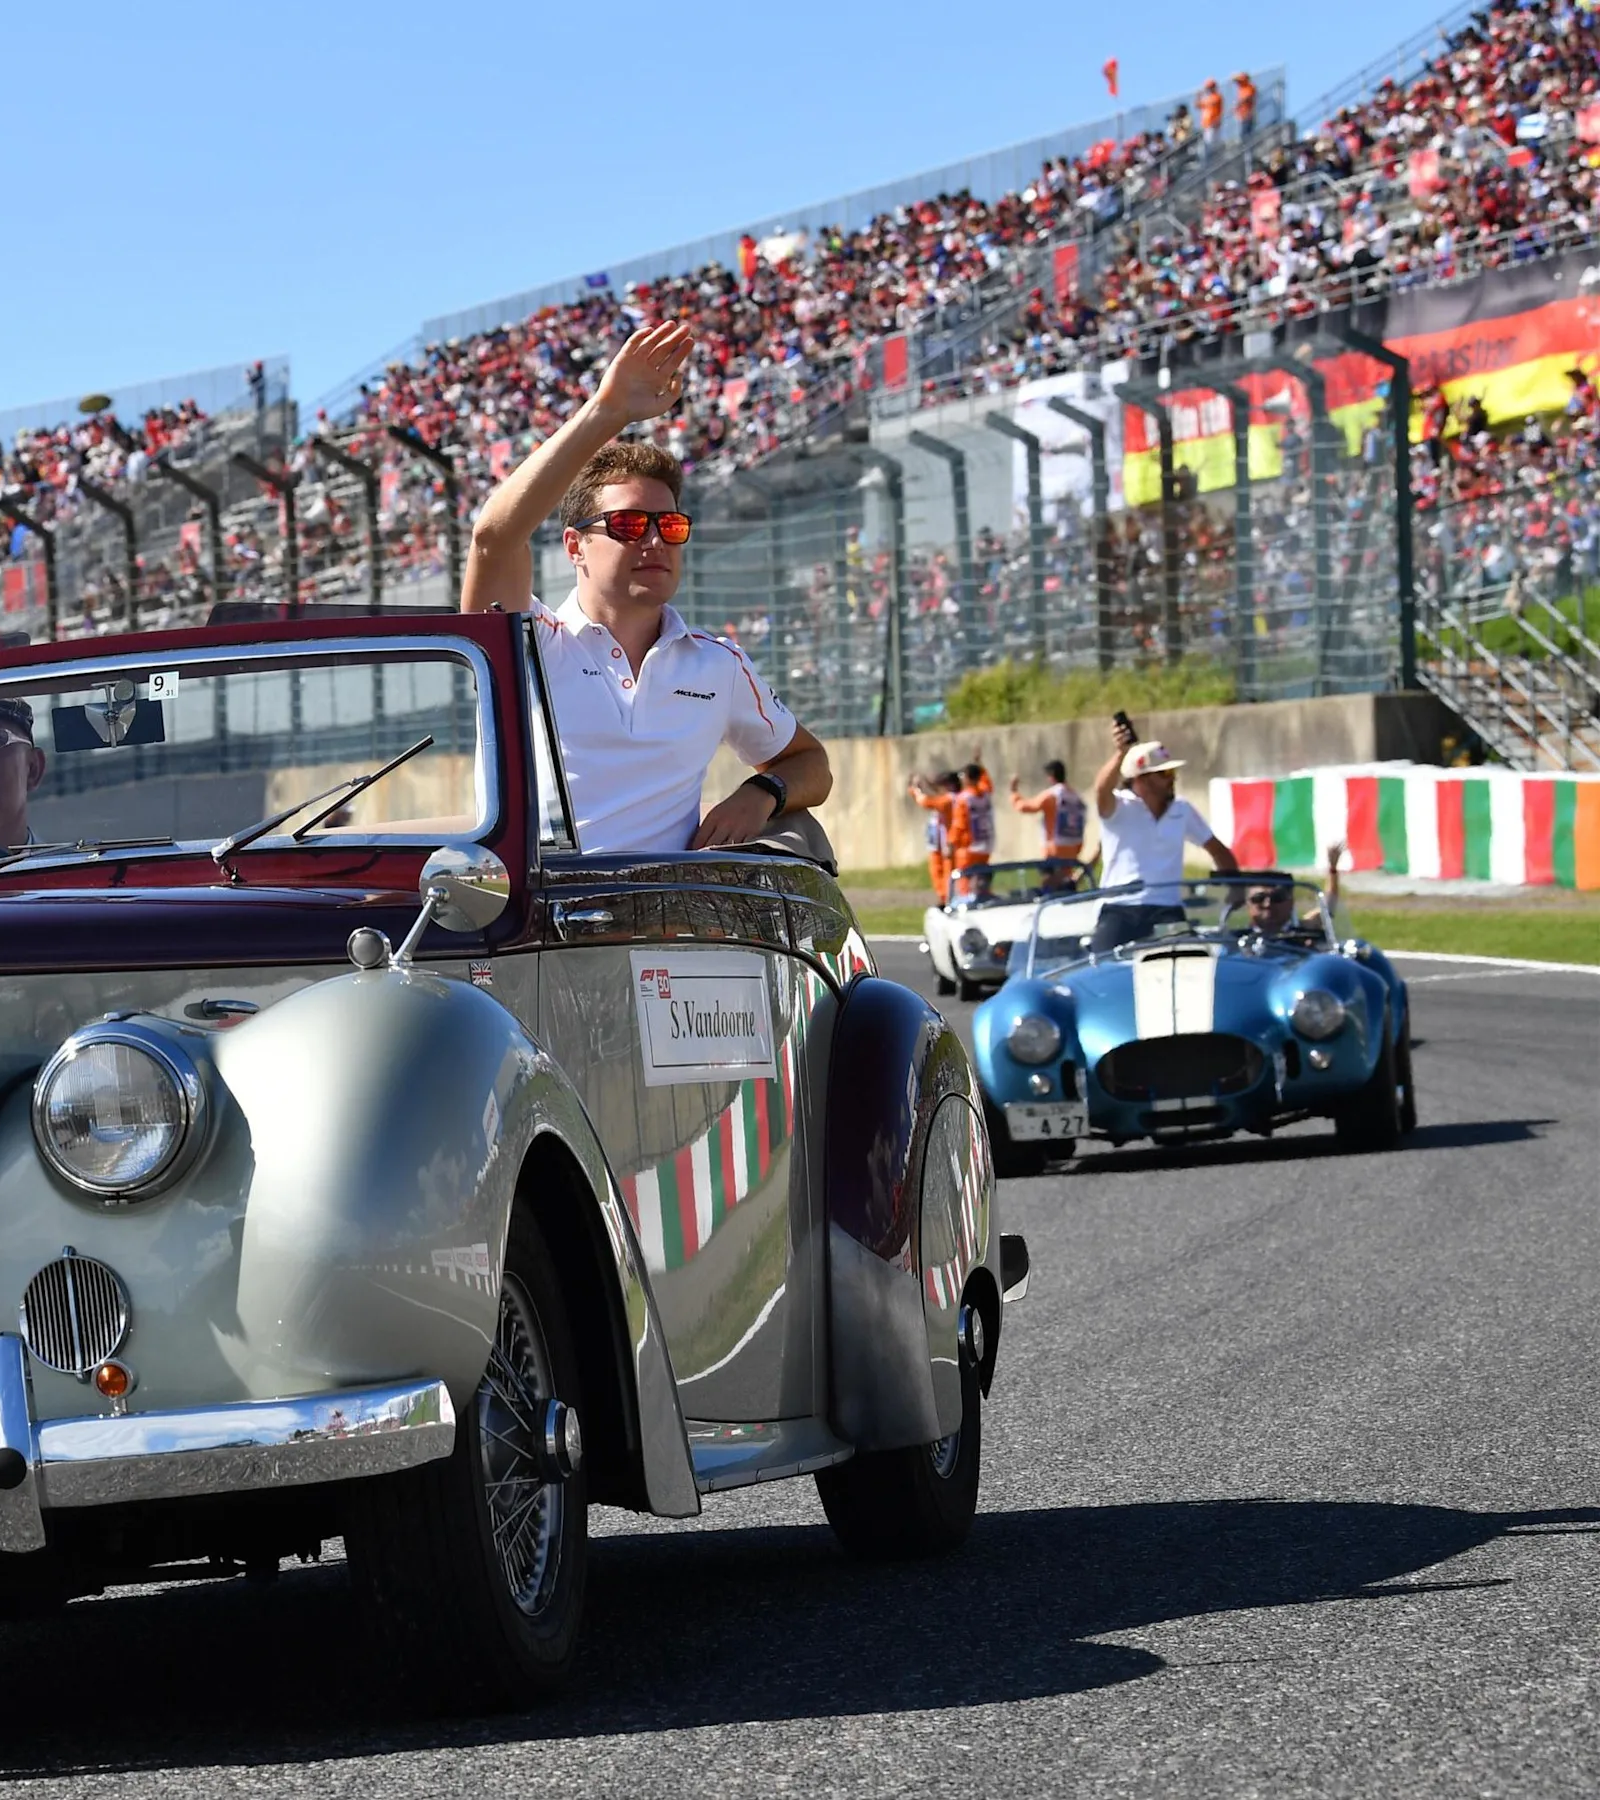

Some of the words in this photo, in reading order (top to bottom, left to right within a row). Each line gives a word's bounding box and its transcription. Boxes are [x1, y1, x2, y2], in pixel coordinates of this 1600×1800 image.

[154, 676, 164, 691] 9
[673, 689, 711, 700] McLaren
[670, 1000, 755, 1039] S.Vandoorne
